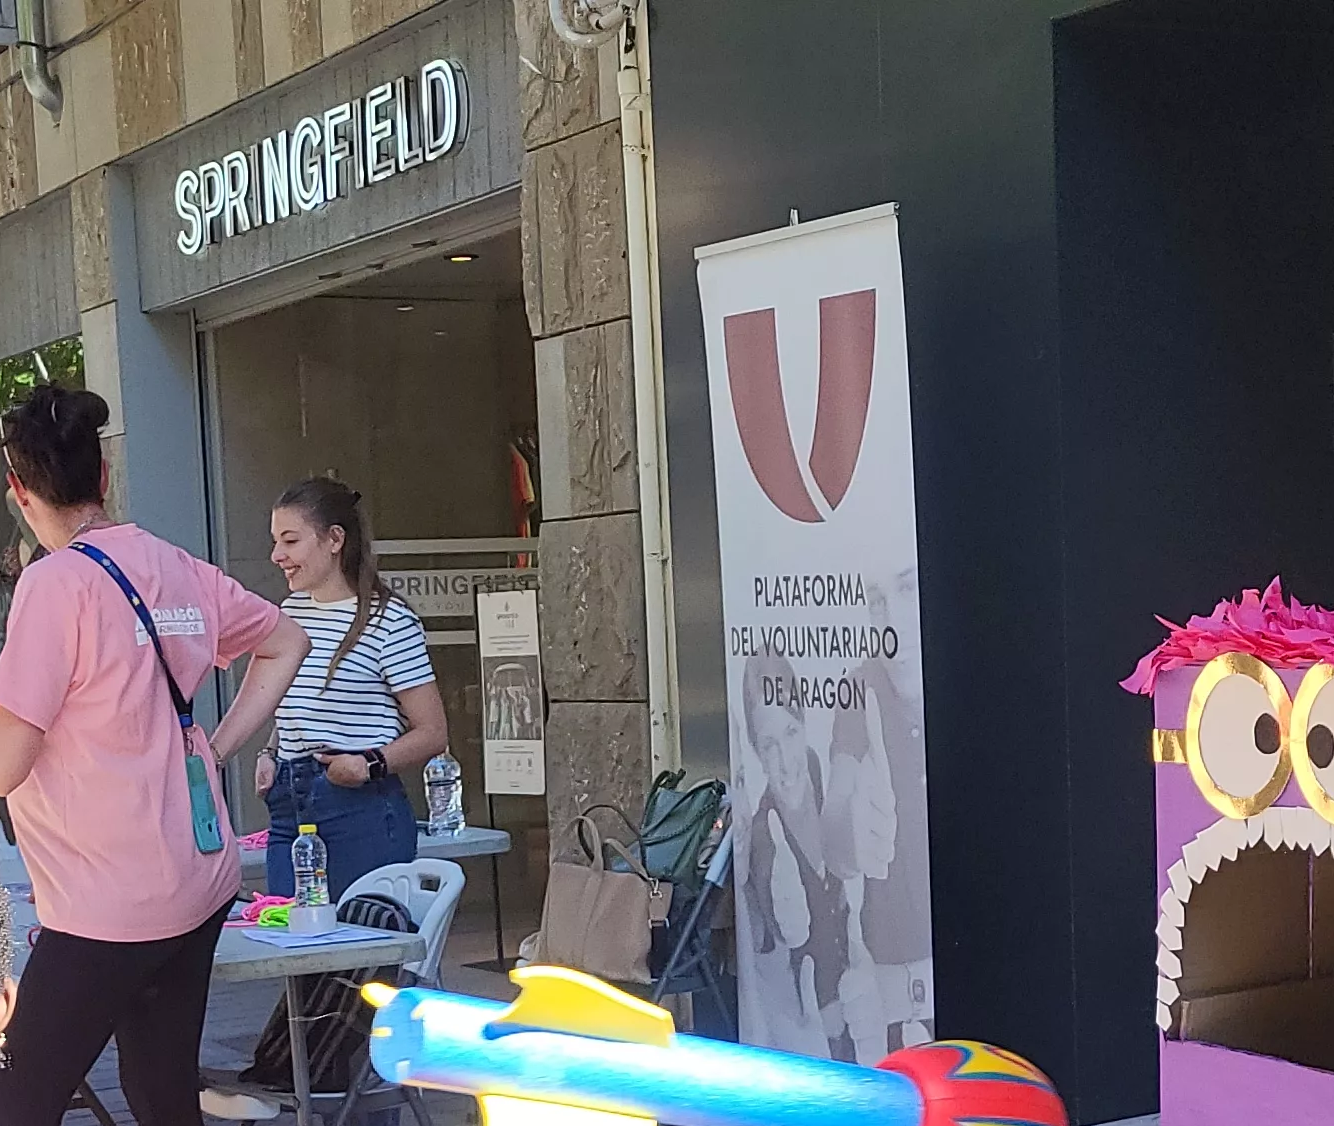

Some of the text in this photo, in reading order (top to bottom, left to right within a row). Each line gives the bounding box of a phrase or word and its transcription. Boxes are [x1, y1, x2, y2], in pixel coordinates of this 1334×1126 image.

[174, 58, 467, 256] SPRINGFIELD
[754, 573, 867, 607] PLATAFORMA
[731, 625, 899, 660] DEL VOLUNTARIADO
[762, 667, 867, 710] DE ARAGÓN
